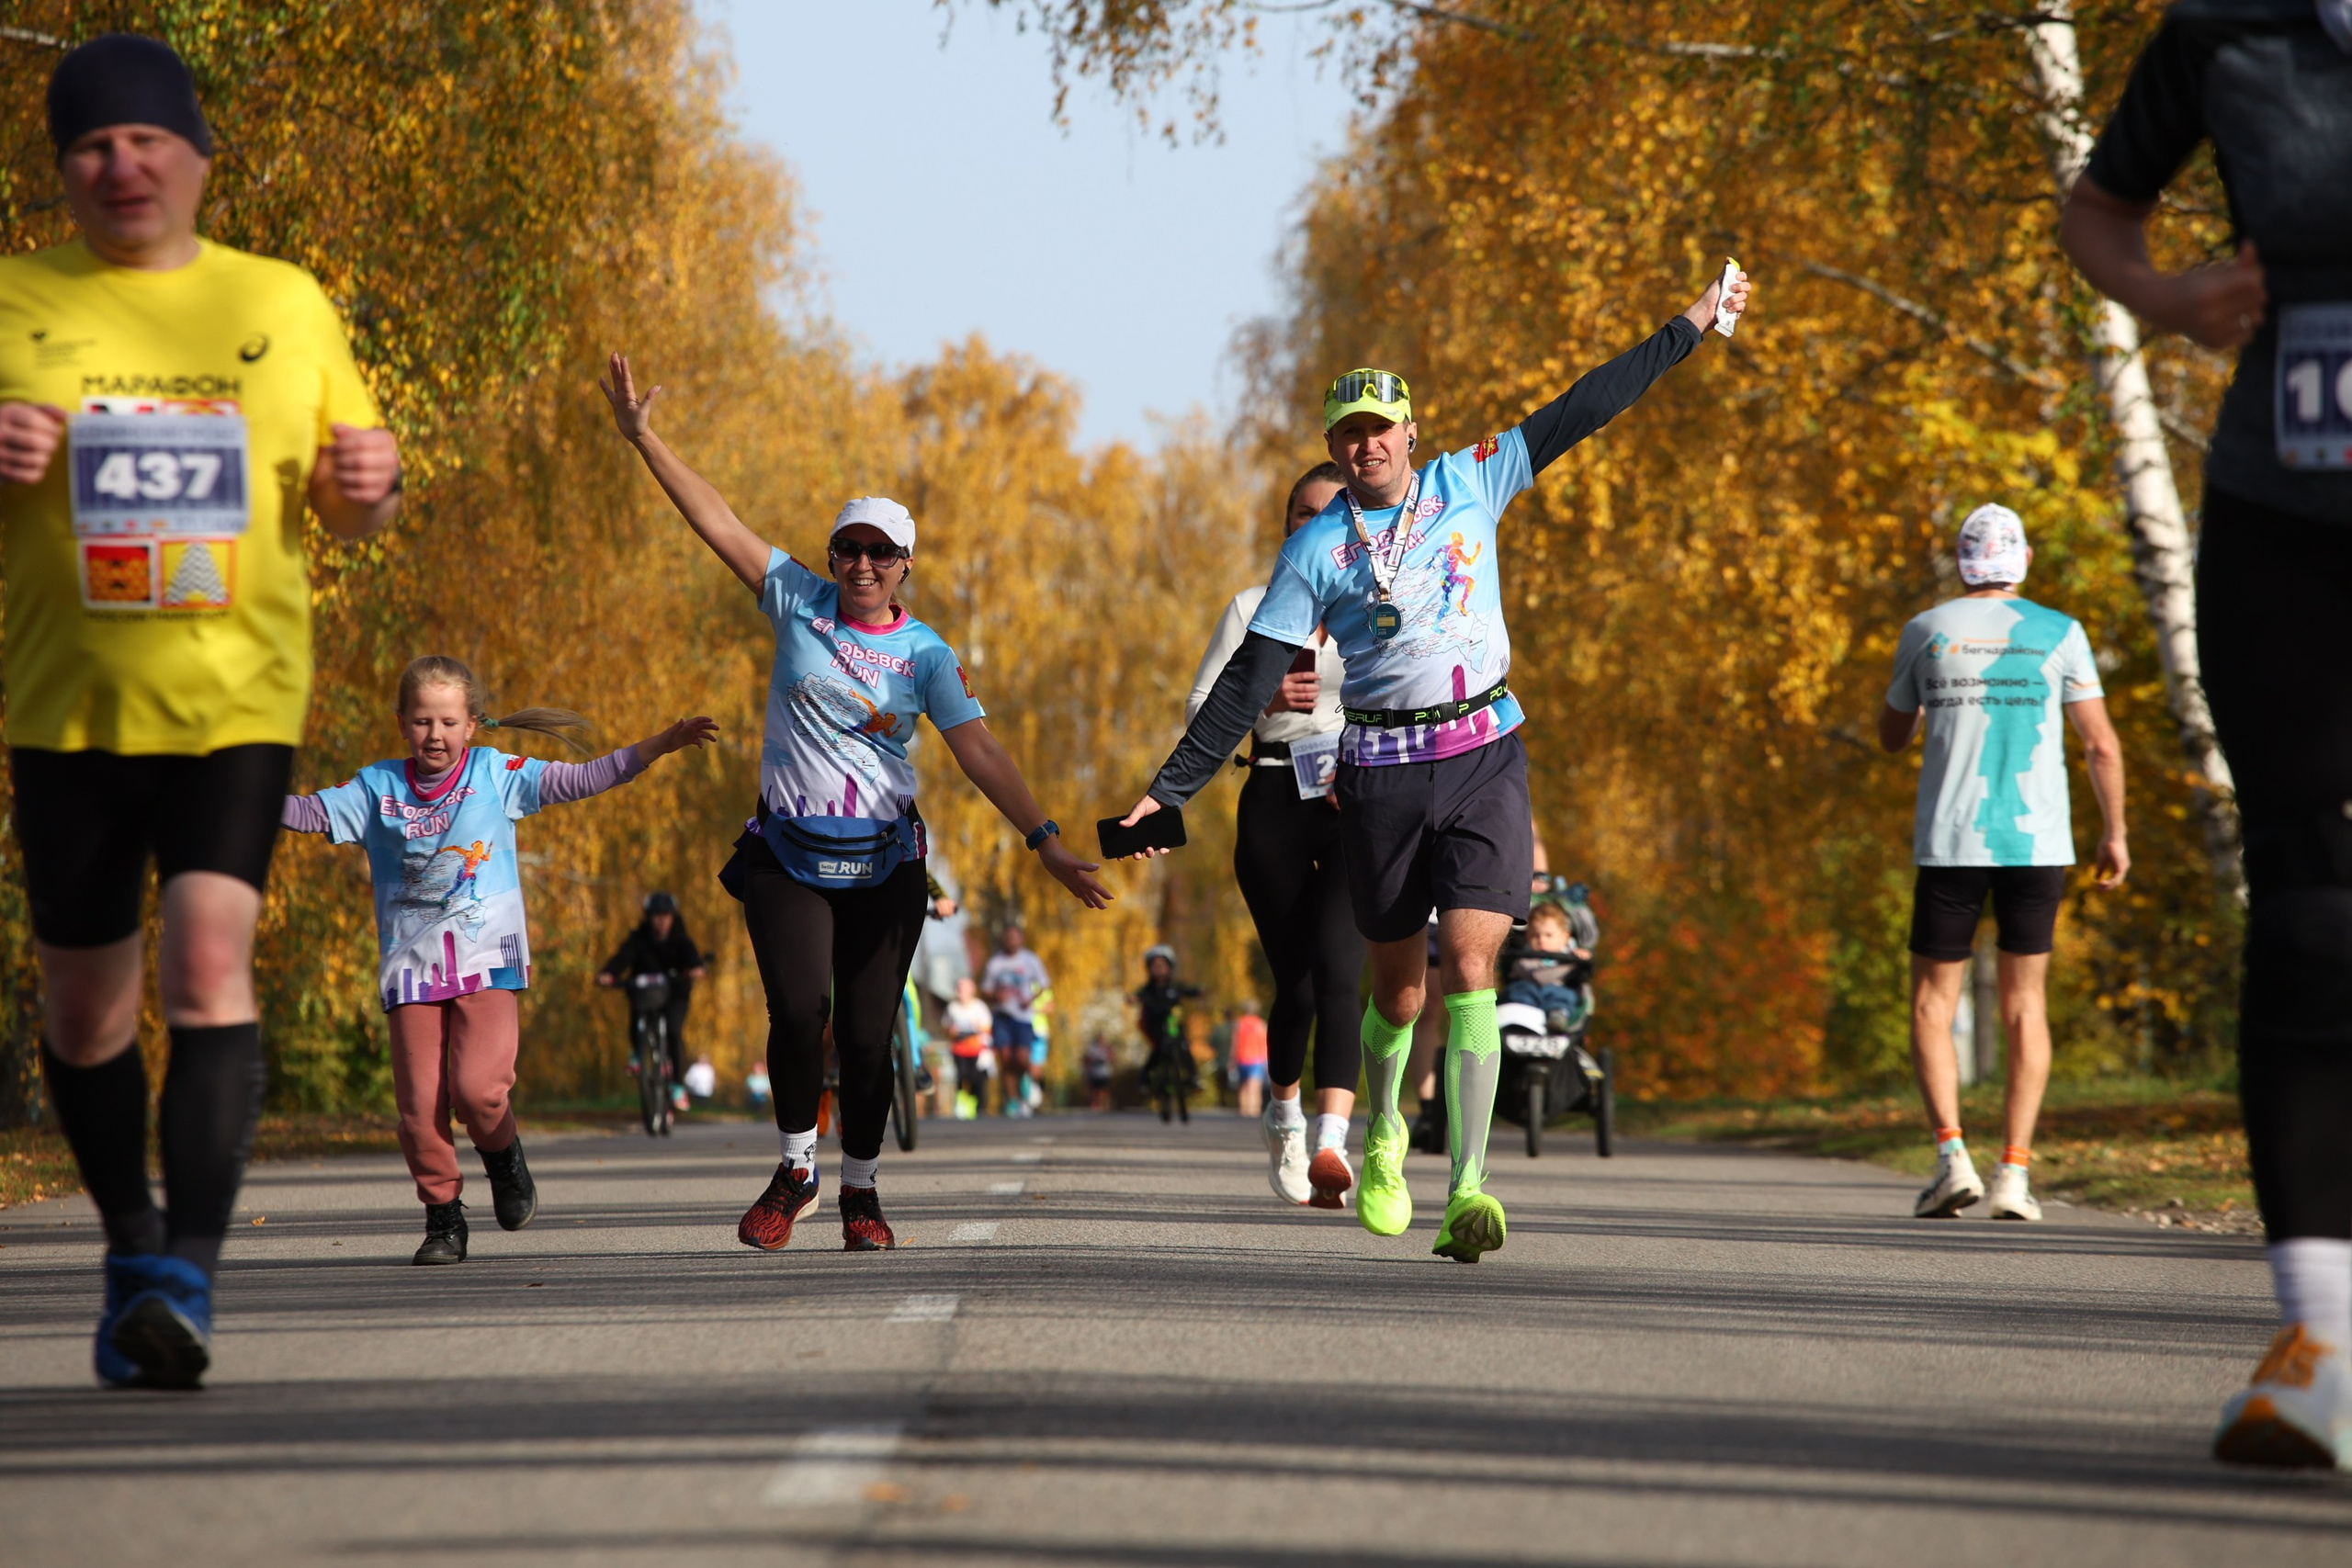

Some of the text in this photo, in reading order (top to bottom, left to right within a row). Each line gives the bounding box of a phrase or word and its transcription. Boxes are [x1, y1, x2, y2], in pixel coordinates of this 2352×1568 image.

[95, 450, 222, 501] 437
[1377, 530, 1427, 569] RN
[831, 650, 880, 689] RUN
[1951, 678, 2029, 688] возможно
[1968, 696, 2001, 706] есть
[405, 811, 451, 840] RUN
[838, 861, 873, 874] RUN
